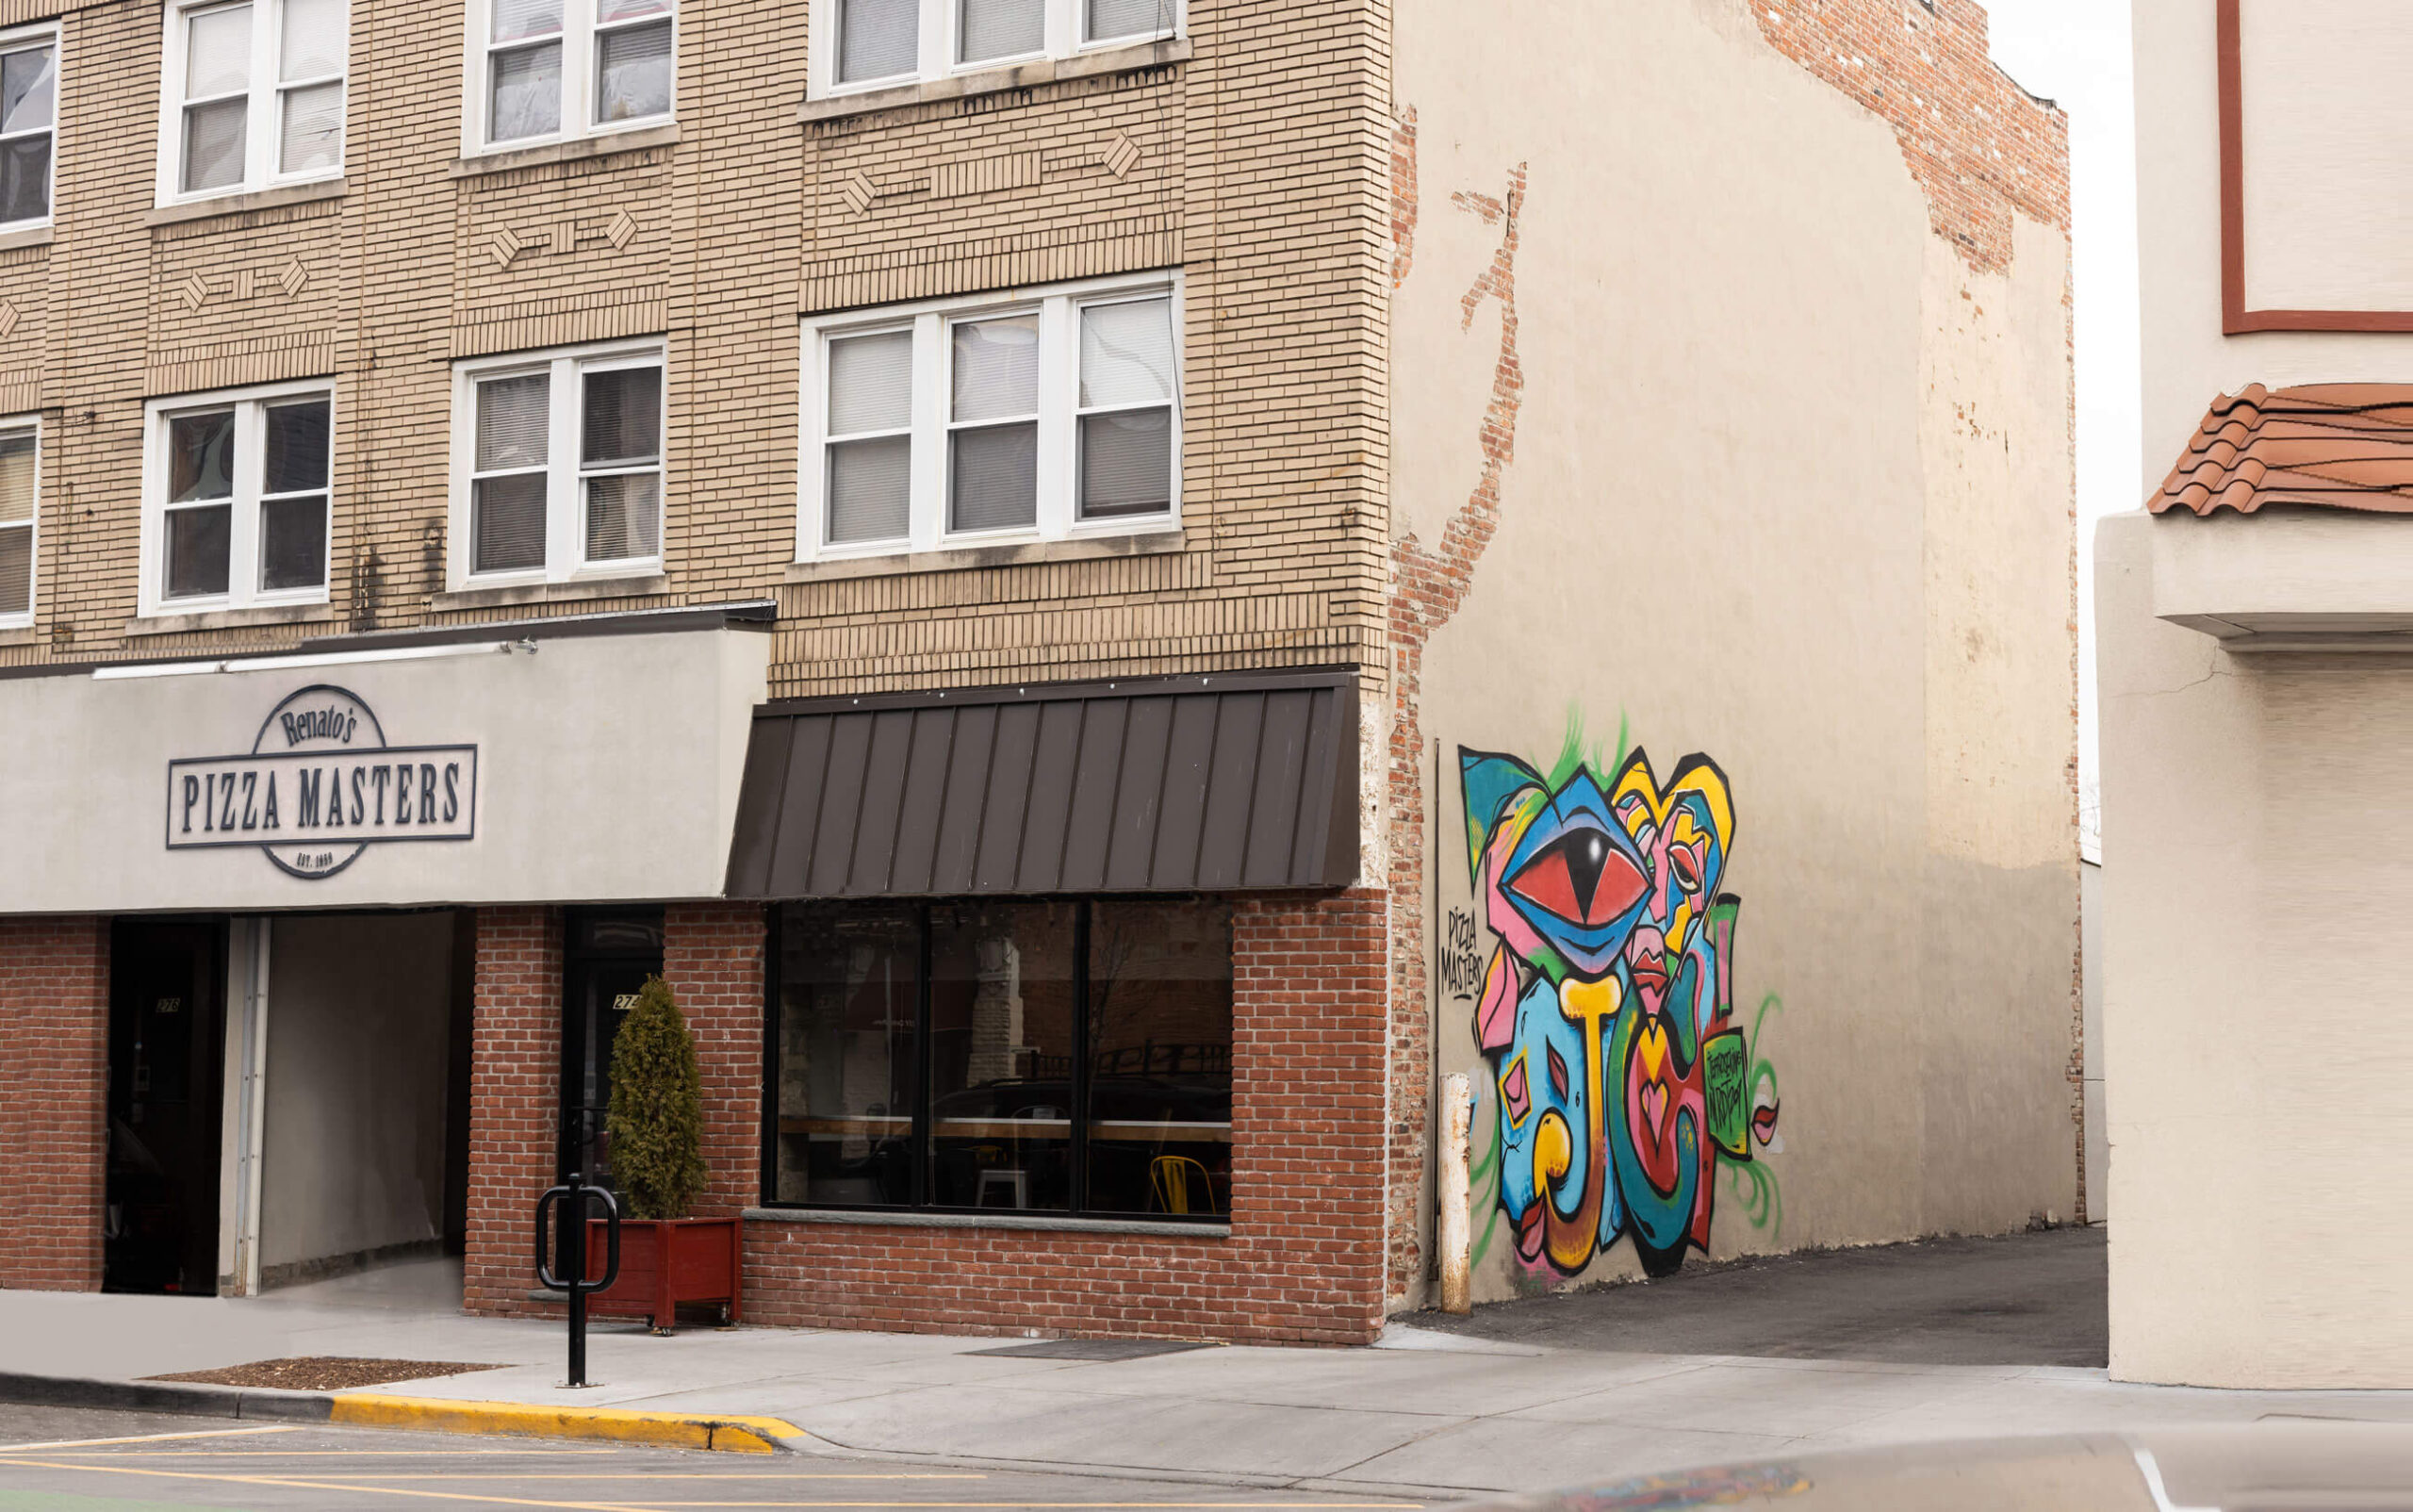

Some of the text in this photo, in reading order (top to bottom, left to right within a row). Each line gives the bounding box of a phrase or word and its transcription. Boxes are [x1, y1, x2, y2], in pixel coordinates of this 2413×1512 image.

[281, 705, 357, 748] Renato's
[182, 762, 459, 832] PIZZA MASTERS
[1441, 945, 1484, 995] MASTERS
